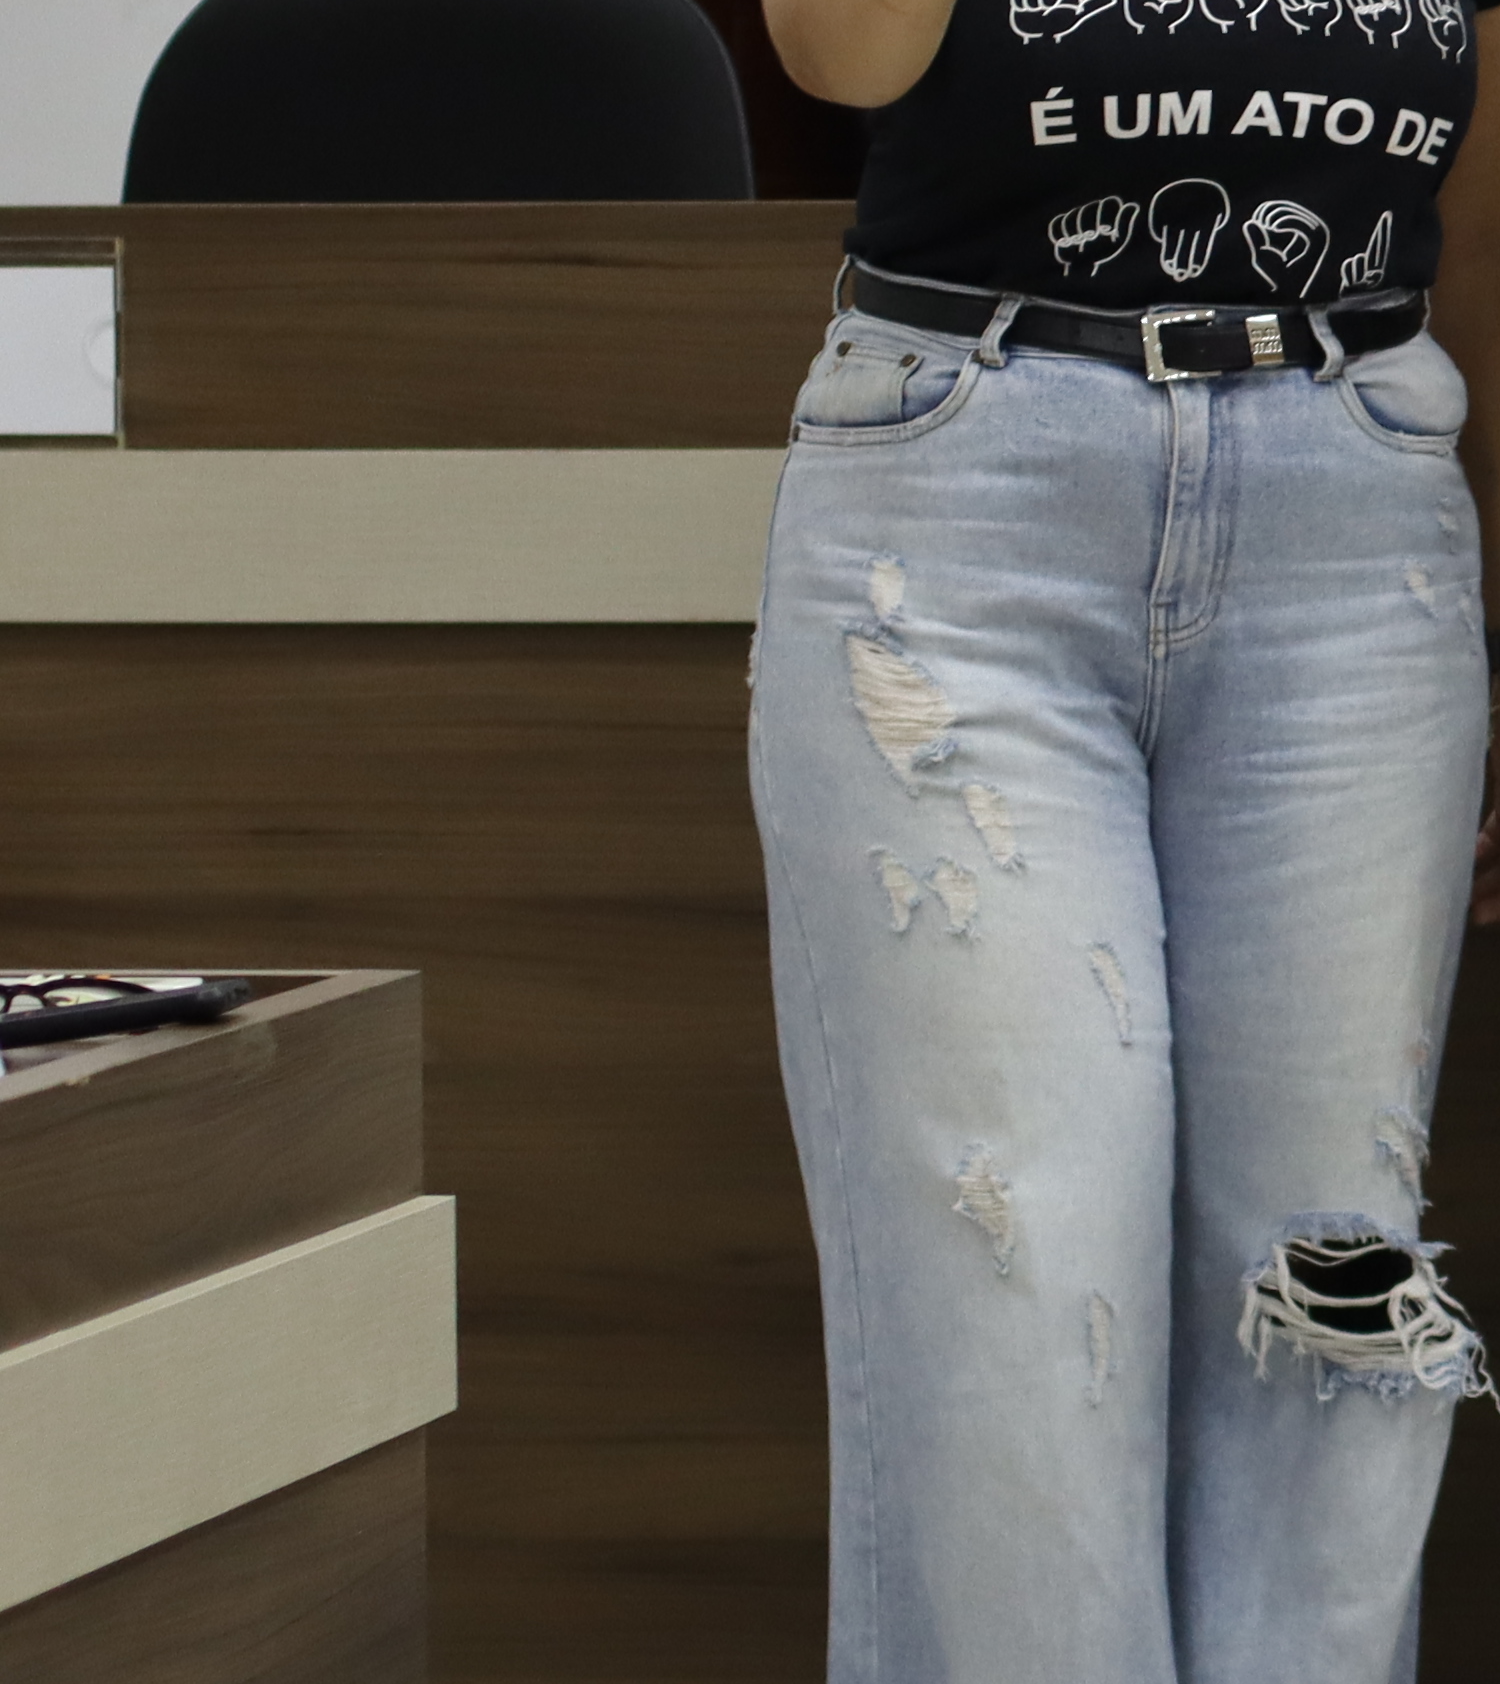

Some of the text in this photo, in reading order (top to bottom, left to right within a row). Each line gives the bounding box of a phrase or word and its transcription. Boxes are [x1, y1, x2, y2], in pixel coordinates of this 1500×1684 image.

[1030, 86, 1454, 166] É UM ATO DE
